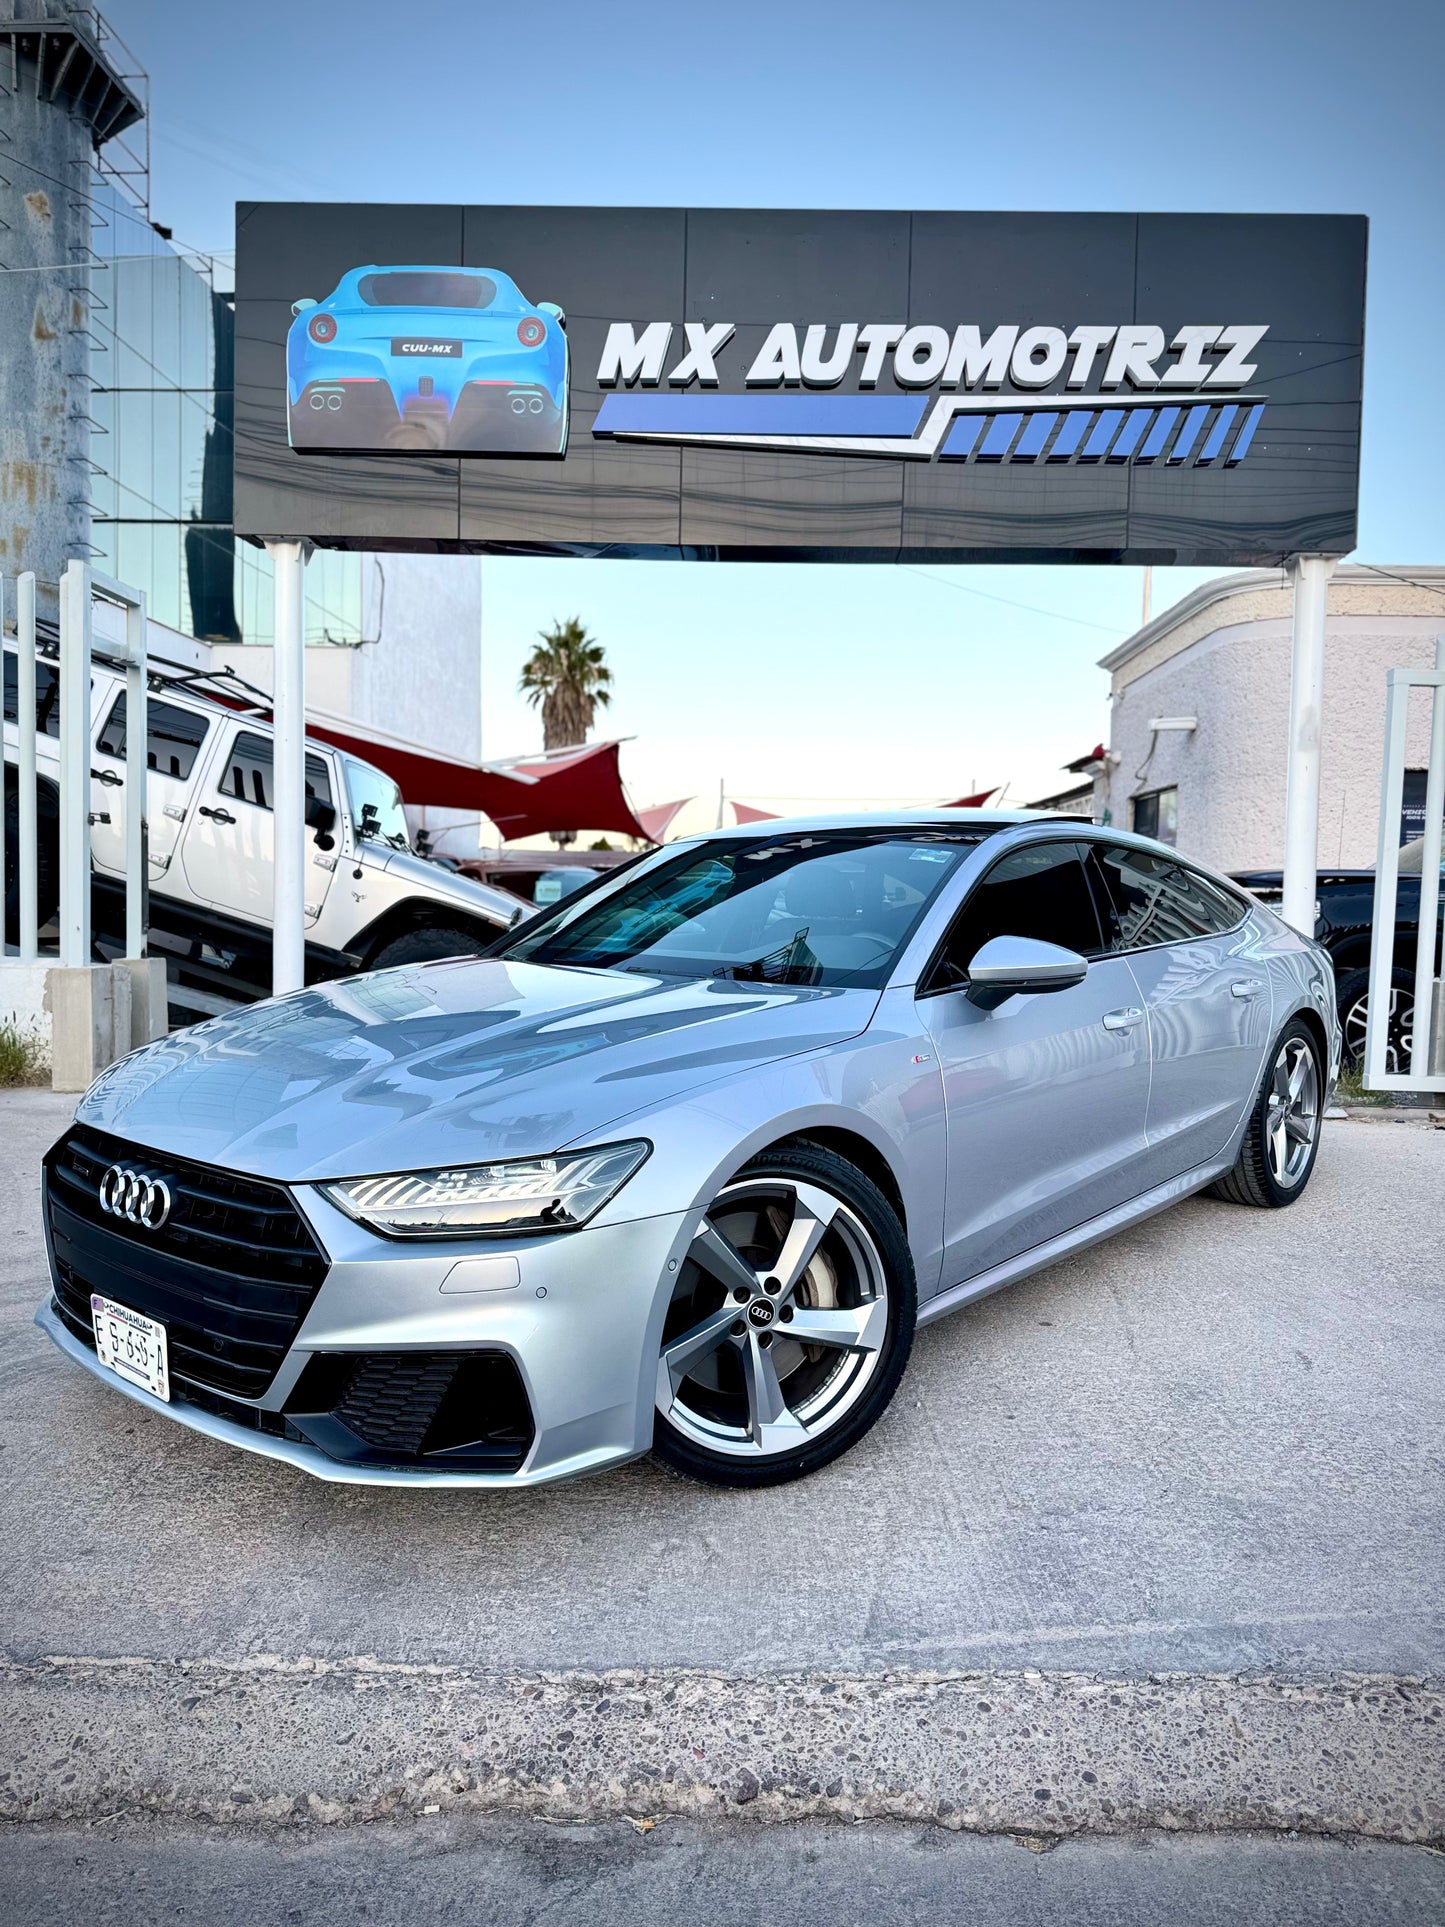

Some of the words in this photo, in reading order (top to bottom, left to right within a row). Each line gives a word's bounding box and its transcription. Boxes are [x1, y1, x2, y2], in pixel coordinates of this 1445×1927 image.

[402, 344, 452, 353] CUU-MX
[597, 322, 736, 386] MX
[744, 323, 1271, 387] AUTOMOTRIZ
